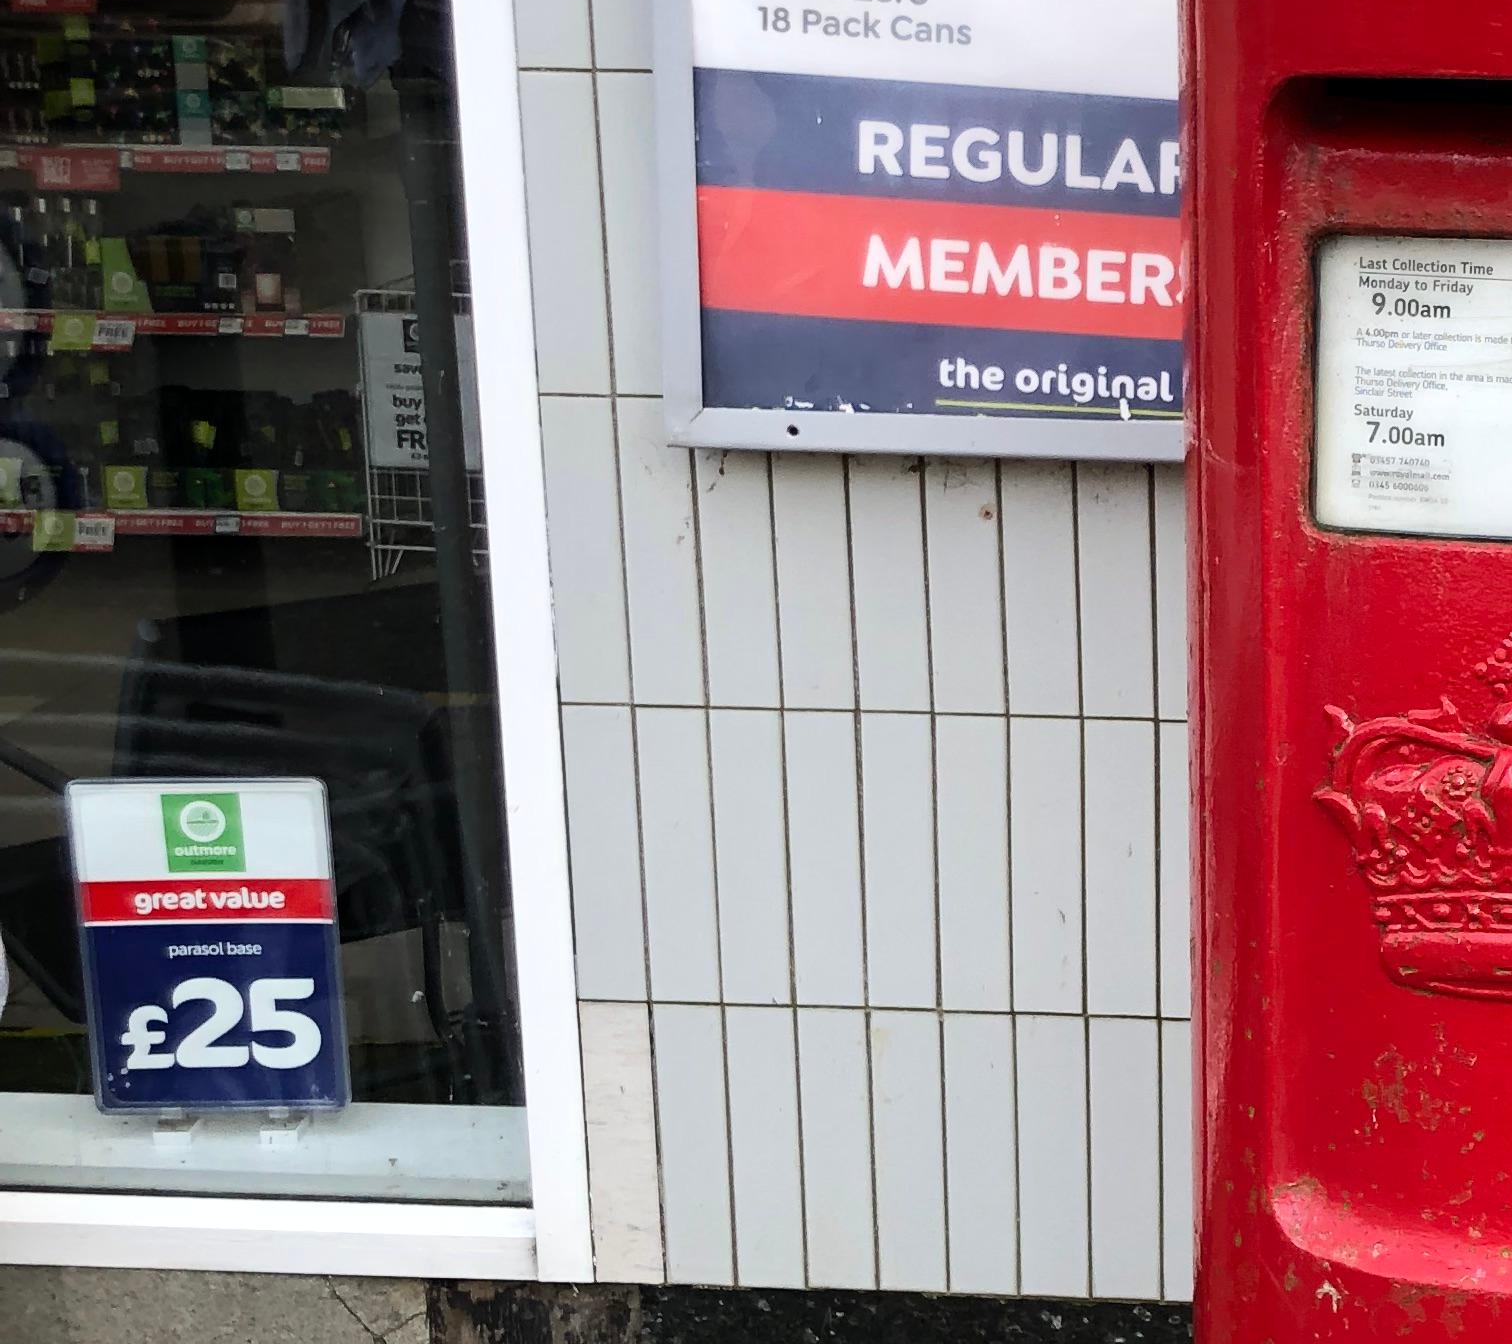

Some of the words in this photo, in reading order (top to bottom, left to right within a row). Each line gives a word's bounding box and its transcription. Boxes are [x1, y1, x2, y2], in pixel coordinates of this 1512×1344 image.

[758, 6, 791, 33] 18
[802, 10, 880, 41] Pack
[889, 15, 972, 46] Cans
[862, 233, 1186, 308] MEMBER
[1359, 256, 1388, 271] Last
[1392, 258, 1456, 274] Collection
[1461, 262, 1494, 276] Time
[1358, 276, 1411, 292] Monday
[1415, 280, 1428, 291] to
[1433, 281, 1474, 296] Friday
[1372, 293, 1451, 318] 9.00am
[1357, 338, 1386, 348] Thurso
[1388, 339, 1422, 352] Delivery
[1424, 340, 1447, 351] Office
[1365, 328, 1398, 339] 4.00pm
[1412, 331, 1432, 340] later
[1434, 332, 1473, 342] collection
[1475, 334, 1482, 343] is
[1485, 335, 1508, 344] made
[938, 356, 1005, 391] the
[1015, 361, 1175, 404] original
[1355, 376, 1383, 387] Thurso
[1386, 378, 1421, 391] Delivery
[1356, 365, 1372, 375] The
[1374, 367, 1396, 377] latest
[1398, 369, 1437, 380] collection
[1439, 370, 1447, 380] in
[1450, 371, 1465, 381] the
[1466, 373, 1484, 382] area
[1354, 387, 1385, 397] Sinclair
[1387, 388, 1413, 398] Street
[1354, 403, 1414, 421] Saturday
[396, 429, 426, 450] FR
[1366, 420, 1446, 447] 7.00am
[174, 844, 237, 858] outmore
[134, 887, 207, 915] great
[209, 886, 286, 909] value
[168, 943, 224, 959] parasol
[226, 943, 262, 956] base
[121, 976, 322, 1070] £25
